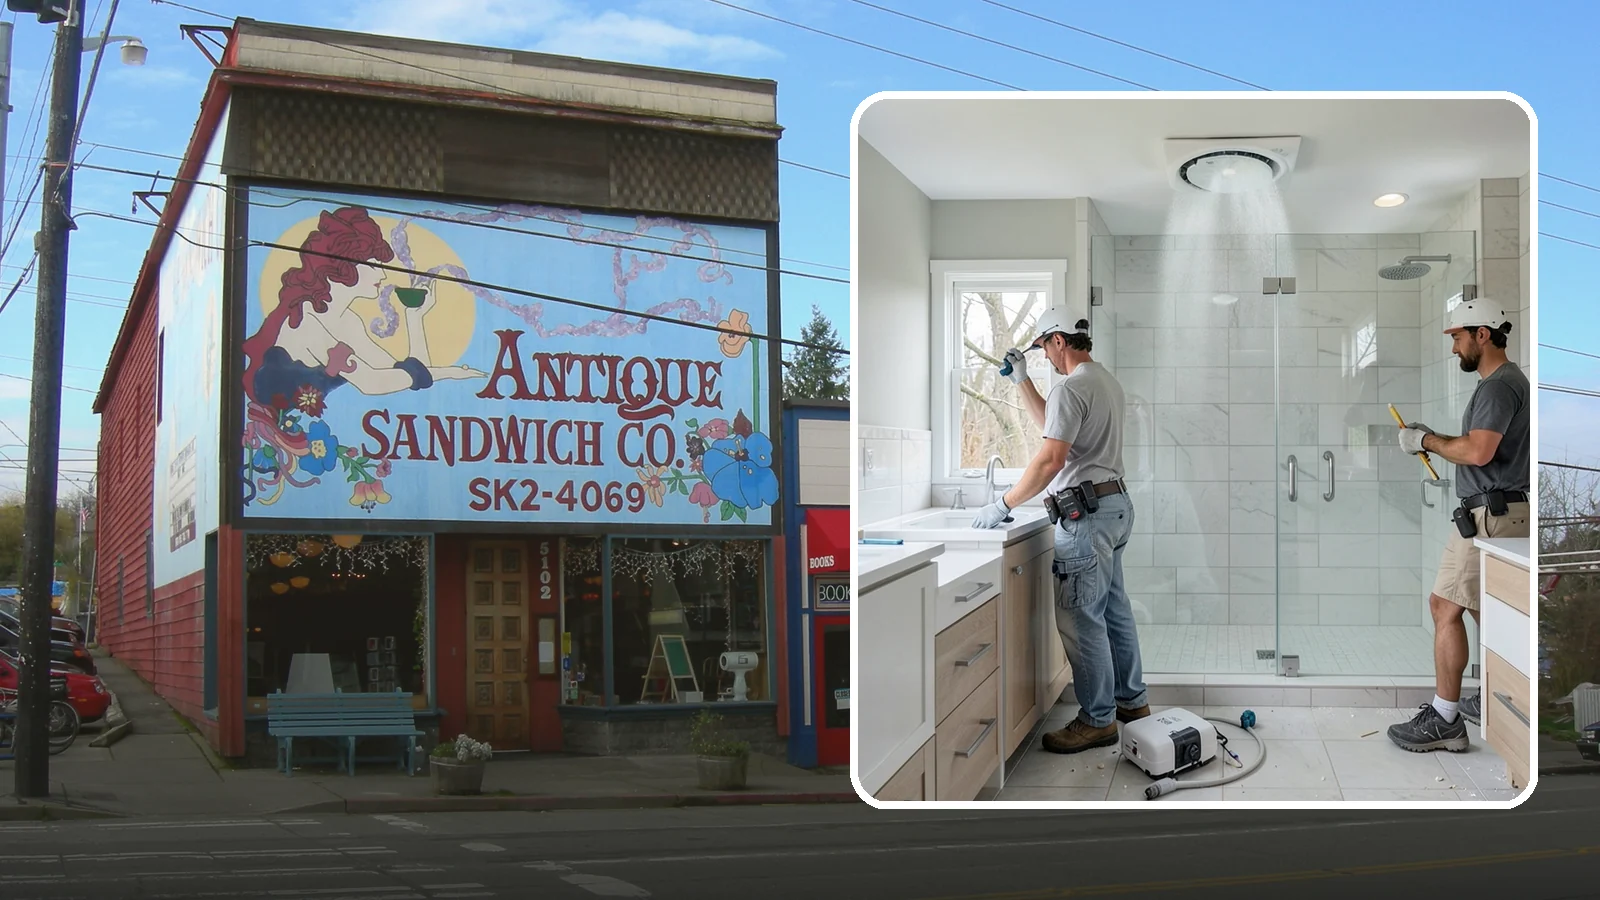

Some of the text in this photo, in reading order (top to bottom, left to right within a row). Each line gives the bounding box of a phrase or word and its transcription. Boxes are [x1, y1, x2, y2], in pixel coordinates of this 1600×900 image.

[475, 328, 723, 421] ANTIQUE
[361, 408, 685, 468] SANDWICH CO.
[468, 477, 646, 513] SK2-4069
[540, 541, 551, 600] 5102
[809, 555, 835, 569] BOOKS
